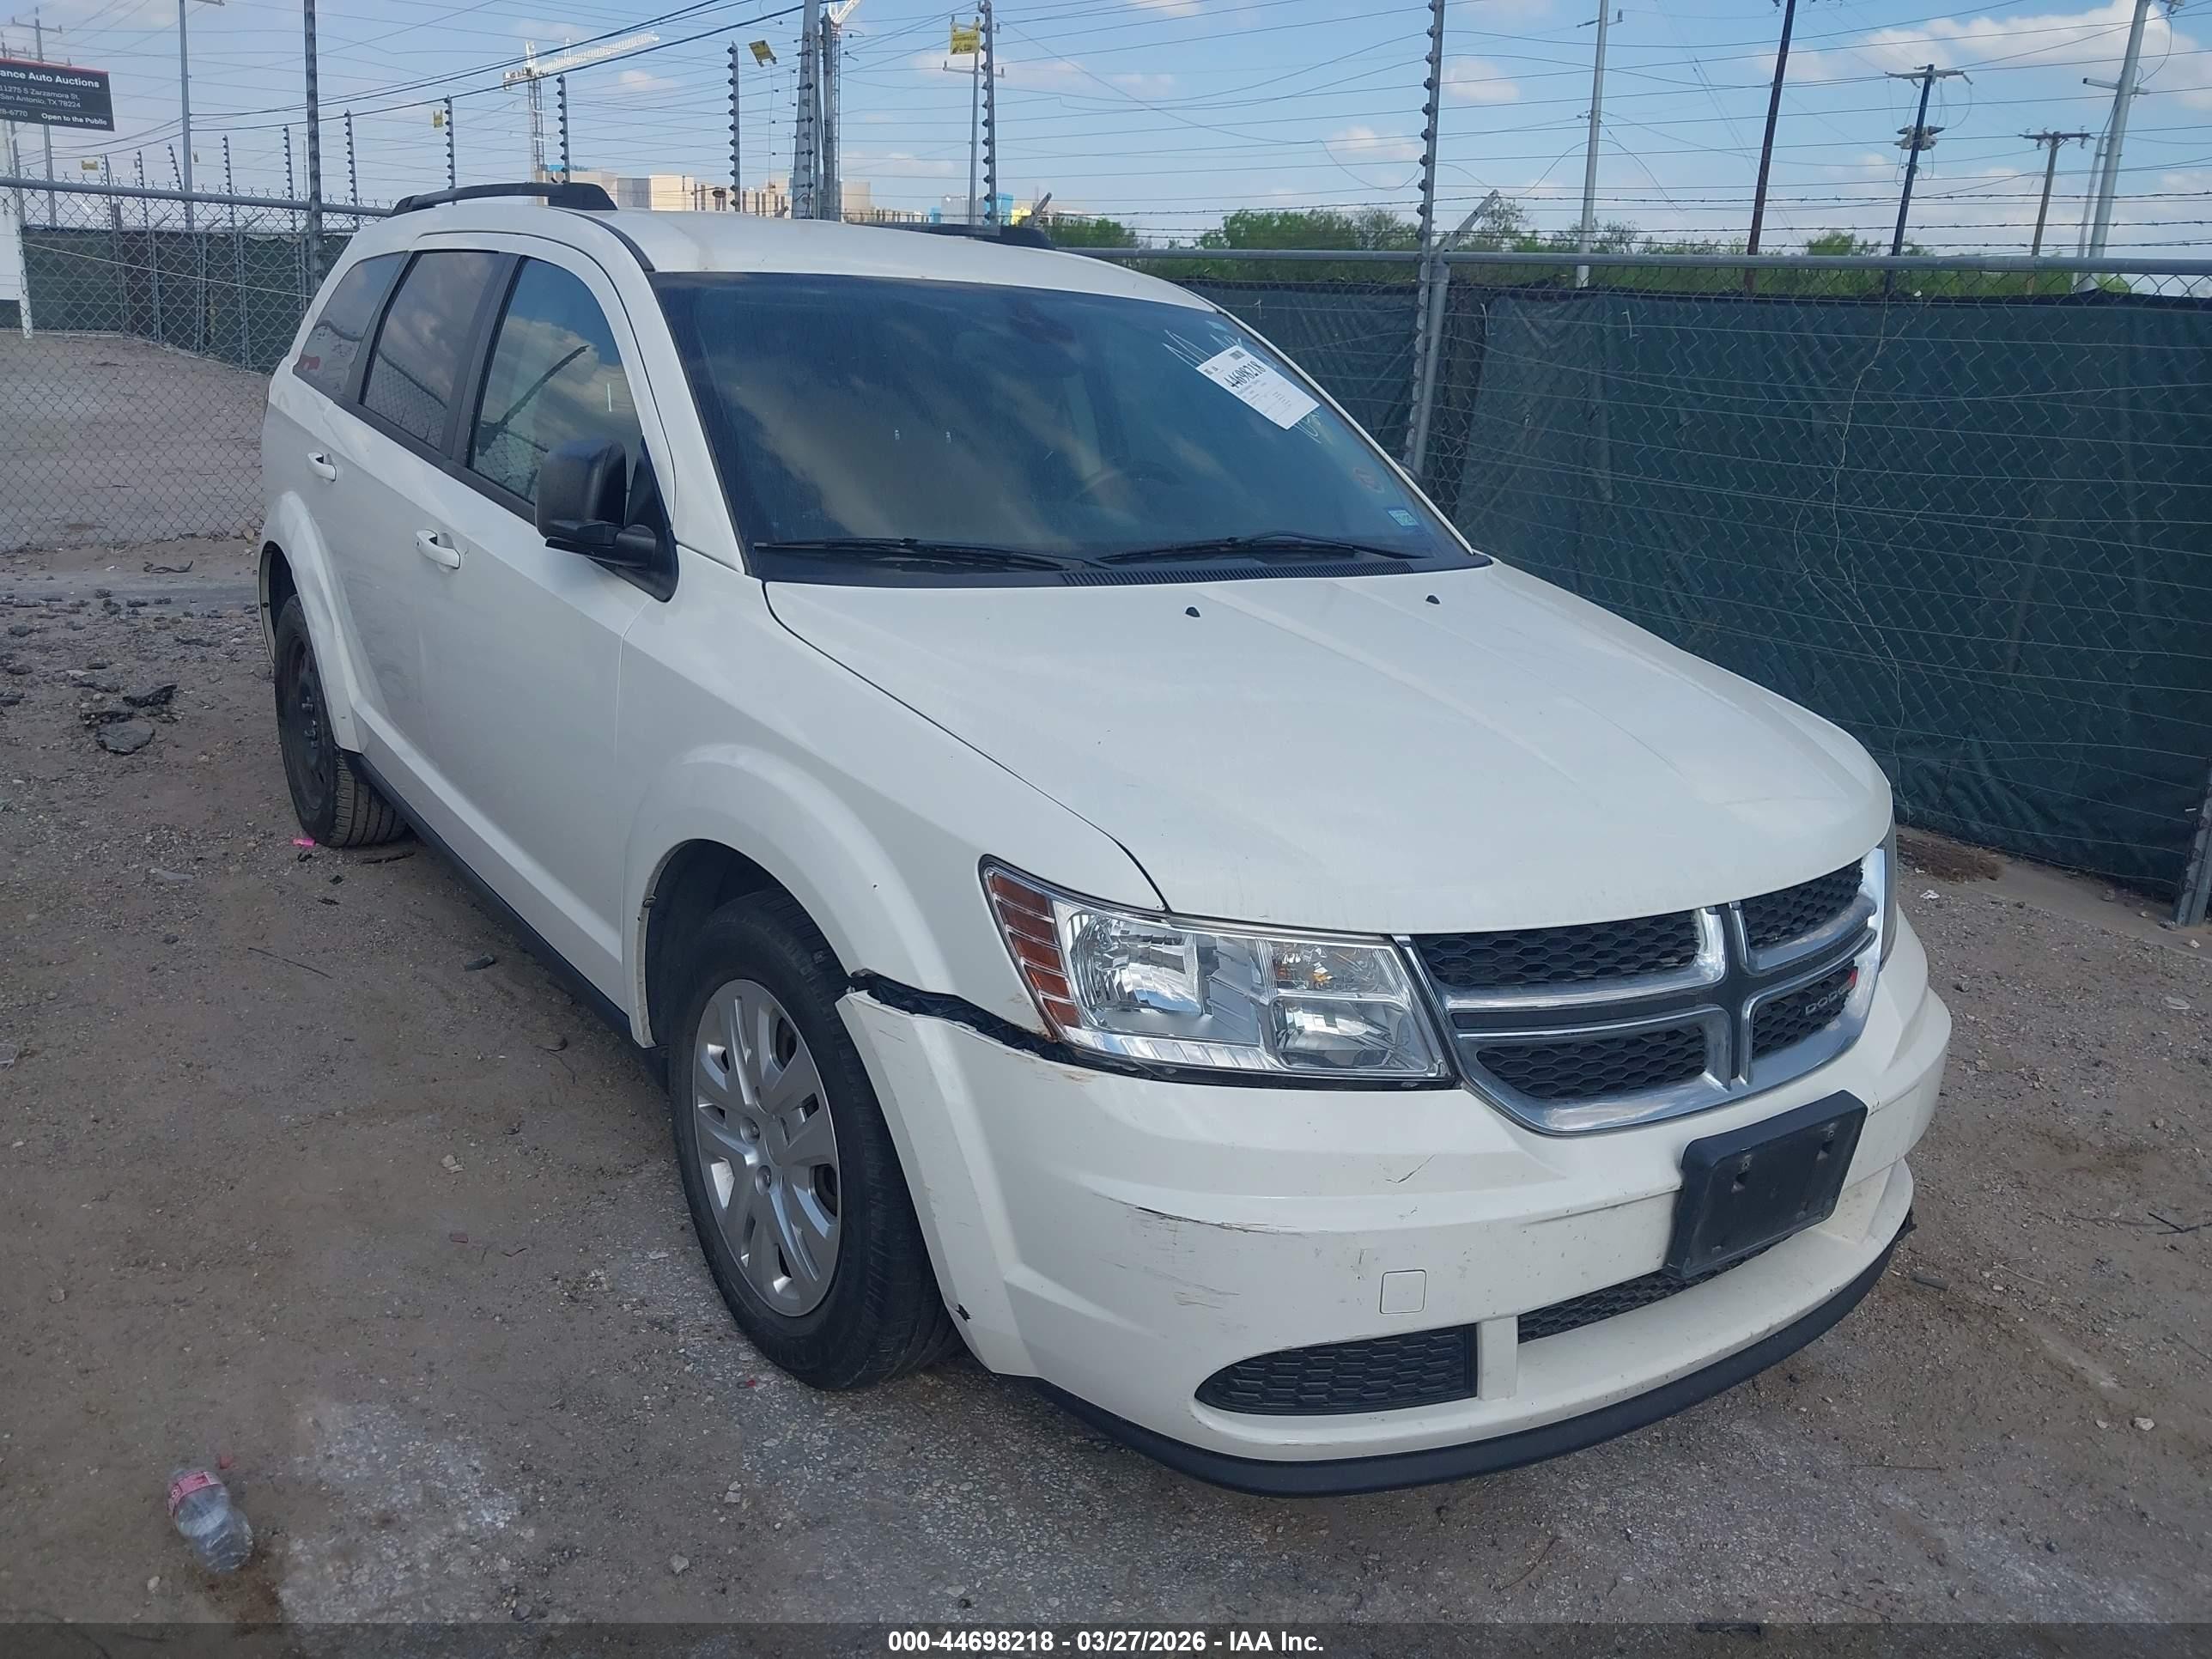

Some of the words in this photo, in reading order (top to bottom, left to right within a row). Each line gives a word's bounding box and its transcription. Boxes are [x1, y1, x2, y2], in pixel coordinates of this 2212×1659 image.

[28, 72, 52, 82] Auto
[55, 75, 100, 88] Auctions
[0, 93, 15, 101] San
[59, 100, 81, 108] 78224
[30, 88, 70, 99] Zarzamora
[41, 112, 62, 121] Open
[85, 117, 107, 125] Public
[1224, 361, 1267, 389] 44698218
